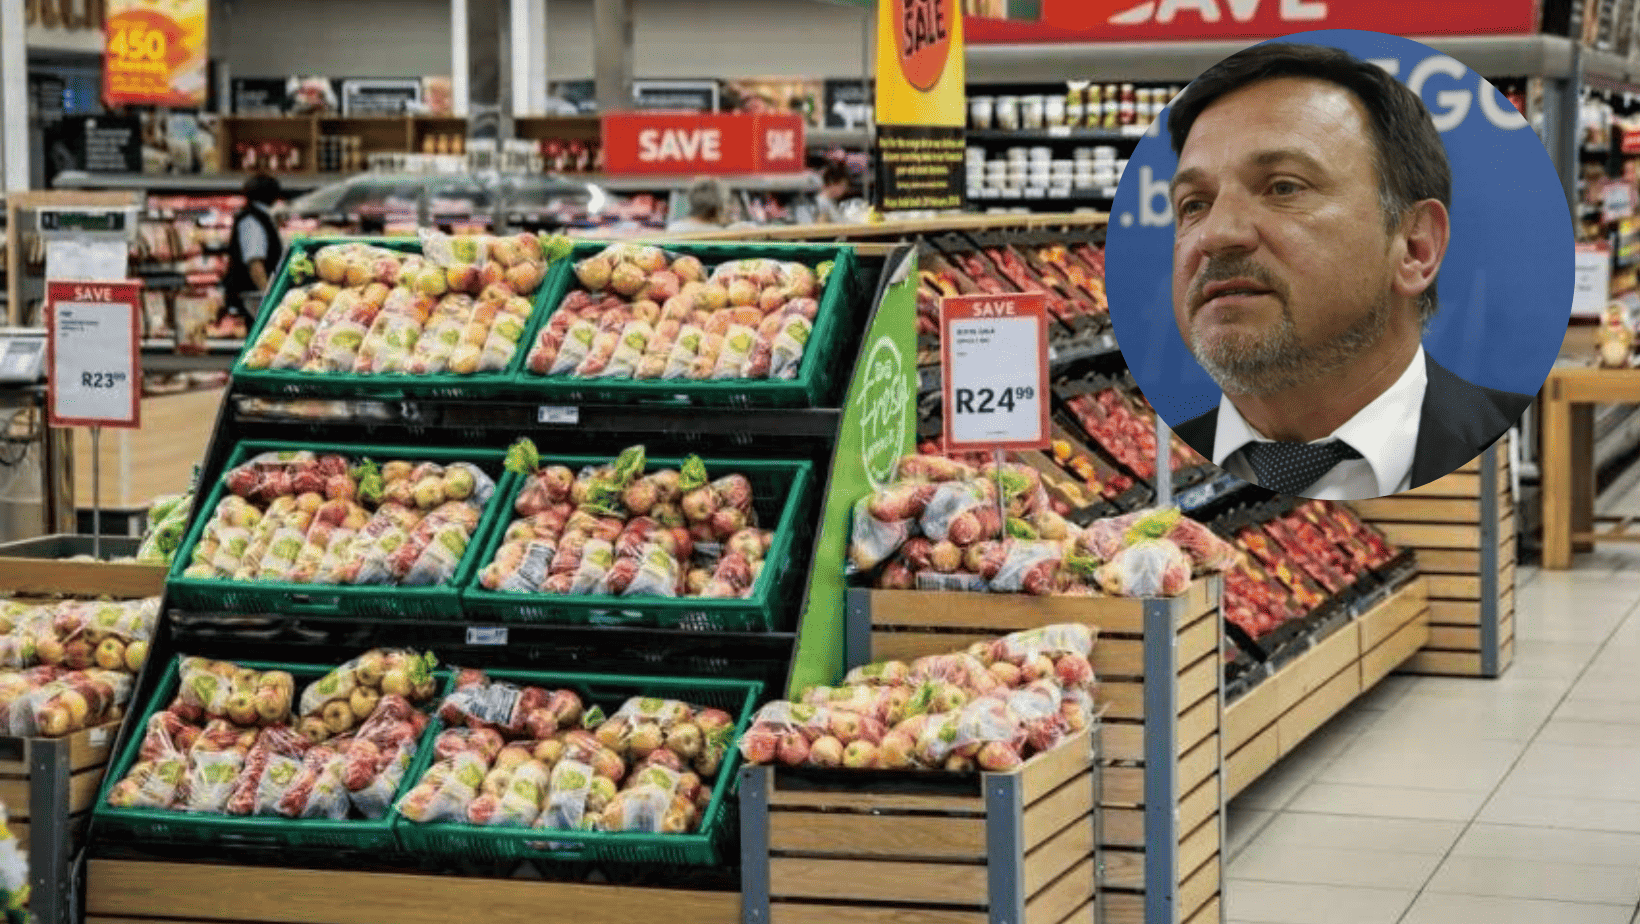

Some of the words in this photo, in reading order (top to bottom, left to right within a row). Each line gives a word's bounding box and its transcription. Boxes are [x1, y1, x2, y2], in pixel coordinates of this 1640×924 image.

[110, 28, 166, 61] 450
[638, 128, 722, 162] SAVE
[73, 286, 112, 302] SAVE
[972, 300, 1016, 317] SAVE
